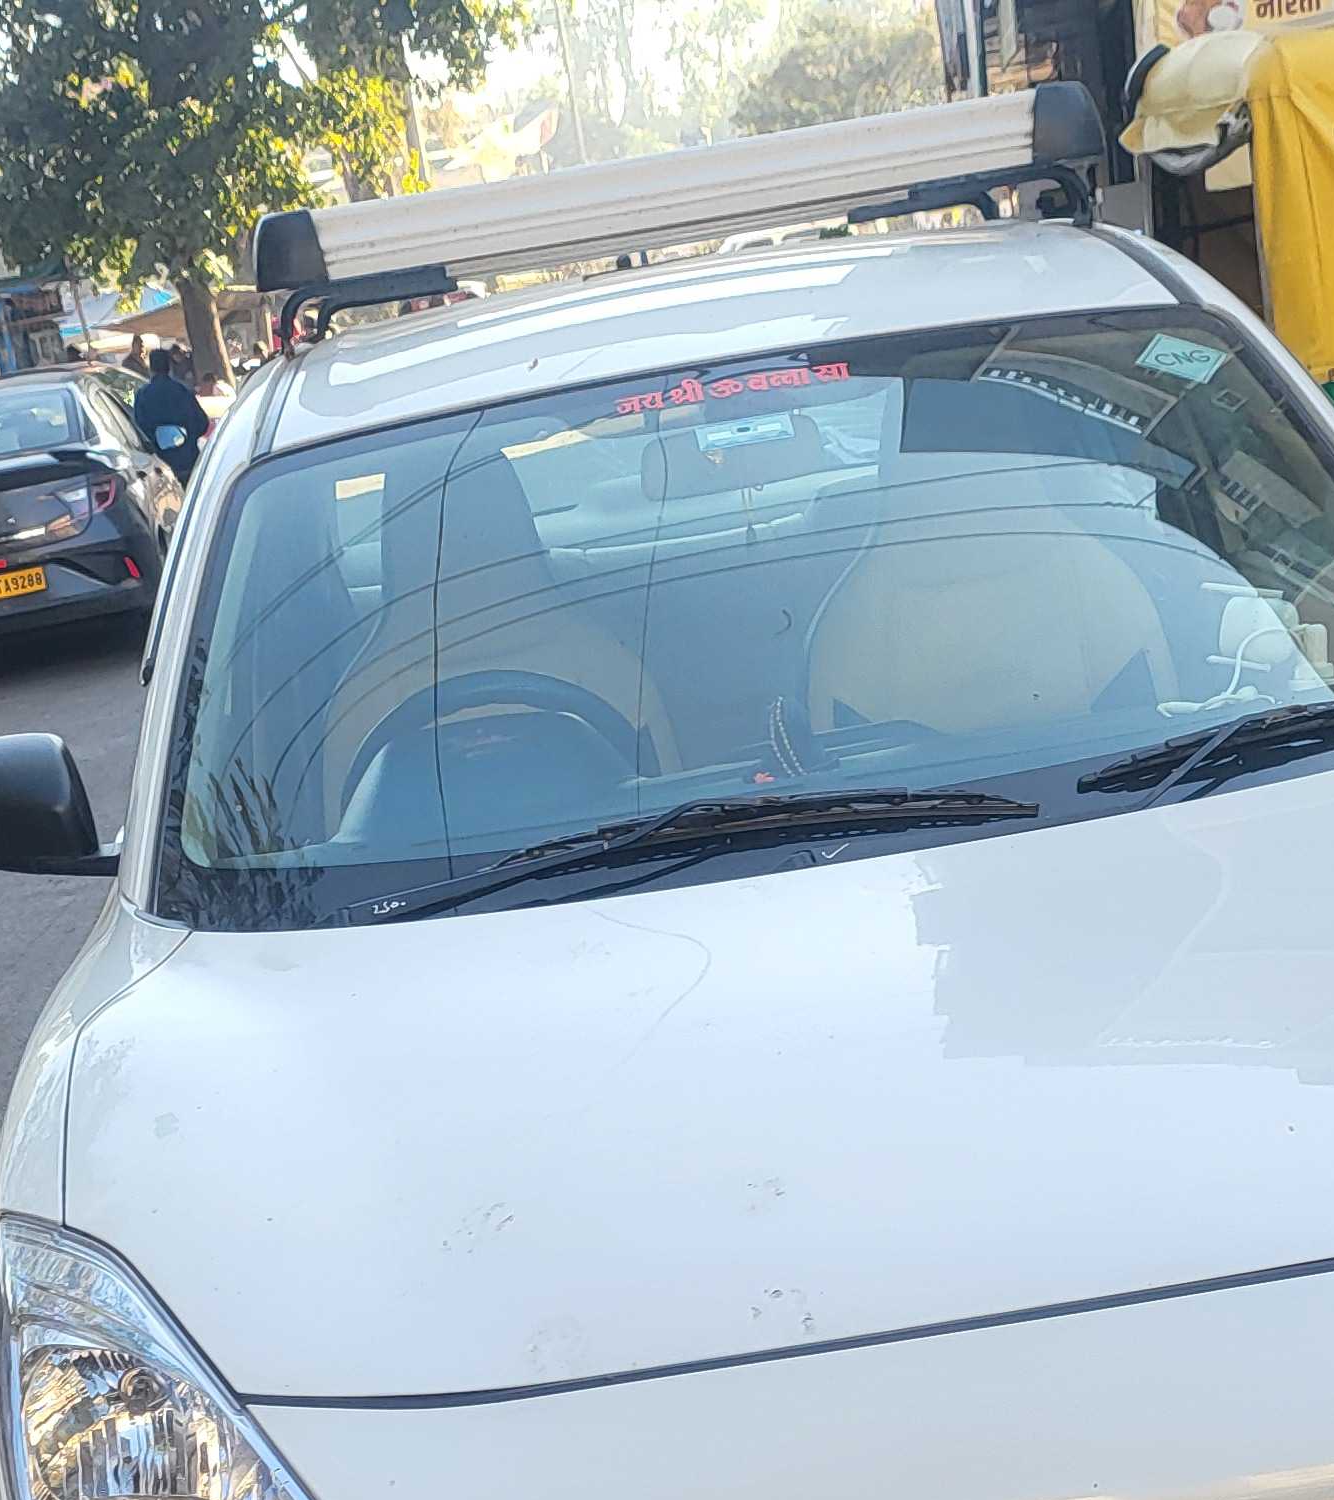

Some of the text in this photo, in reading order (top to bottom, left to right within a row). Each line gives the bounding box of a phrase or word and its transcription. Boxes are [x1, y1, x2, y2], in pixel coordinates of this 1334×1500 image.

[1155, 350, 1211, 366] CNG
[615, 391, 666, 415] जय
[670, 378, 705, 405] श्री
